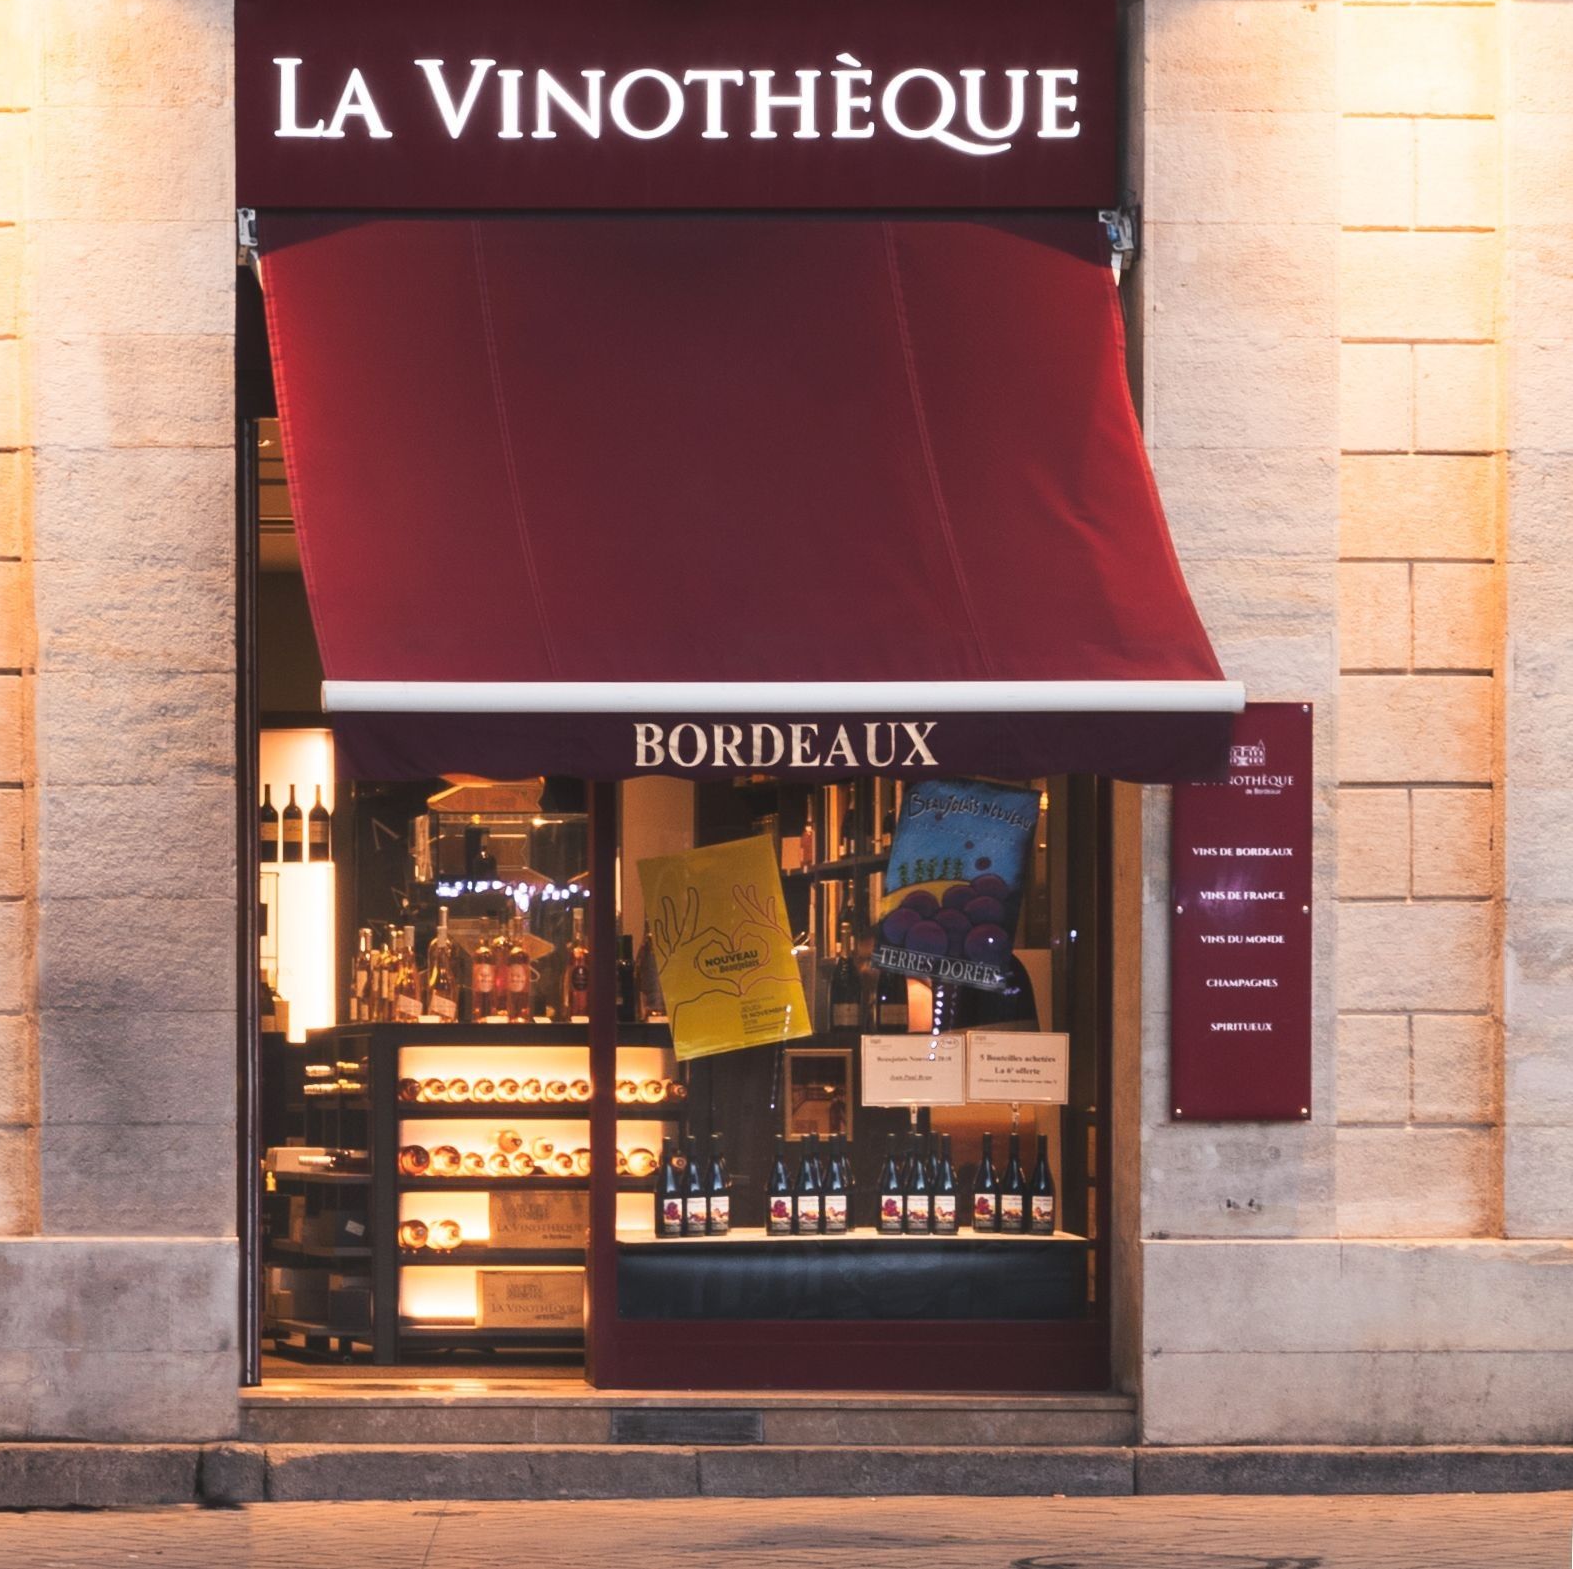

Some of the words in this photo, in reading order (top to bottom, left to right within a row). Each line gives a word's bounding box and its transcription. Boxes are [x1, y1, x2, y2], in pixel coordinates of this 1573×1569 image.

[272, 56, 393, 140] LA
[414, 52, 1081, 156] VINOTHÈQUE
[633, 721, 939, 767] BORDEAUX
[1192, 847, 1217, 856] VINS
[1219, 847, 1233, 856] DE
[1235, 847, 1293, 856] BORDEAUX
[1200, 891, 1226, 900] VINS
[1227, 891, 1242, 900] DE
[1243, 891, 1285, 900] FRANCE
[1200, 935, 1225, 944] VINS
[1227, 935, 1243, 944] DU
[1245, 935, 1286, 944] MONDE
[705, 950, 759, 968] NOUVEAU
[879, 947, 934, 973] TERRES
[1205, 978, 1279, 988] CHAMPAGNES
[1210, 1022, 1273, 1032] SPIRITUEUX
